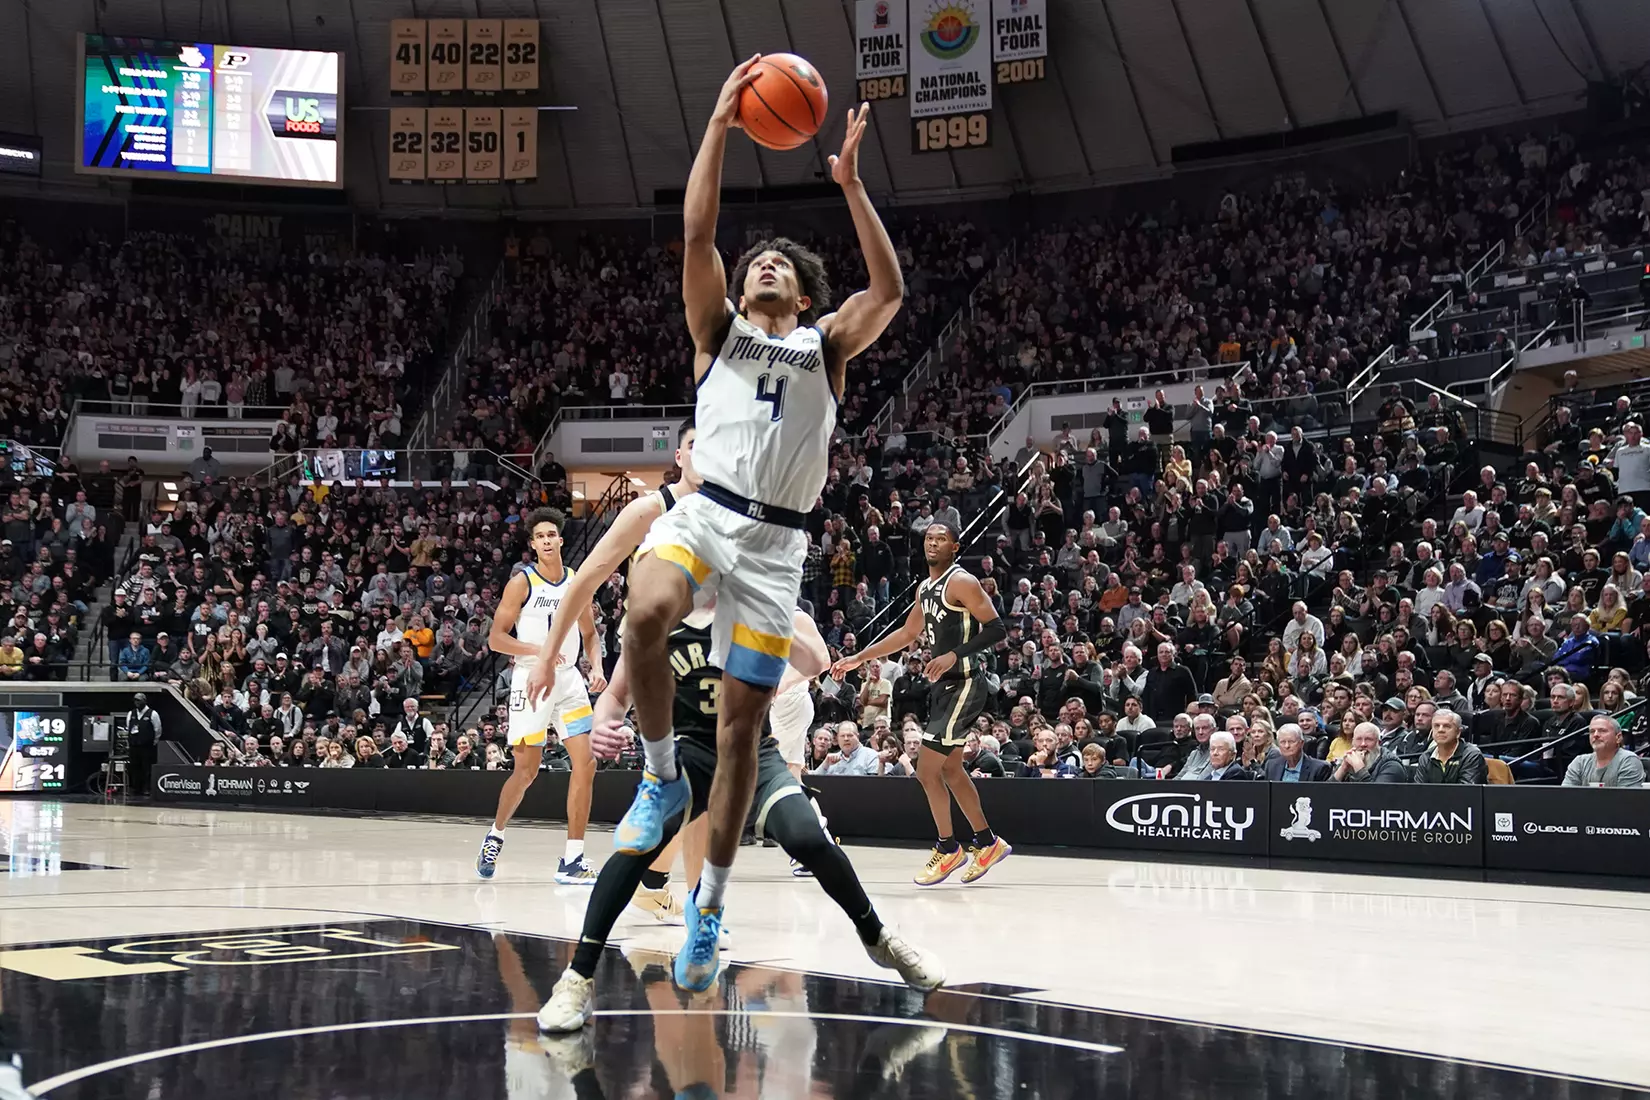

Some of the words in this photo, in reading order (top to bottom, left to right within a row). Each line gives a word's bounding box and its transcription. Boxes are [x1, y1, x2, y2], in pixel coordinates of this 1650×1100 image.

[996, 15, 1042, 36] FINAL
[859, 33, 903, 53] FINAL
[1000, 31, 1040, 52] FOUR
[396, 43, 421, 65] 41
[431, 43, 461, 65] 40
[470, 43, 499, 65] 22
[507, 42, 536, 65] 32
[862, 50, 901, 70] FOUR
[920, 71, 981, 90] NATIONAL
[997, 58, 1045, 84] 2001
[858, 77, 905, 100] 1994
[915, 83, 987, 104] CHAMPIONS
[913, 106, 946, 115] WOMEN'S
[947, 102, 988, 112] BASKETBALL
[286, 120, 320, 133] FOODS
[916, 114, 988, 150] 1999
[392, 131, 422, 154] 22
[430, 131, 460, 153] 32
[468, 131, 498, 153] 50
[517, 131, 525, 152] 1
[214, 213, 284, 238] PAINT
[728, 335, 821, 373] Marquette
[755, 372, 788, 422] 4
[927, 622, 936, 645] 5
[699, 677, 722, 715] 3
[39, 718, 66, 734] 19
[39, 764, 65, 780] 21
[163, 777, 201, 790] InnerVision
[218, 777, 253, 791] ROHRMAN
[1132, 794, 1254, 840] unity
[1329, 807, 1472, 831] ROHRMAN
[1137, 826, 1231, 840] HEALTHCARE
[1333, 829, 1417, 843] AUTOMOTIVE
[1423, 832, 1473, 844] GROUP
[1492, 834, 1518, 842] TOYOTA
[1538, 825, 1579, 834] LEXUS
[1596, 827, 1641, 836] HONDA
